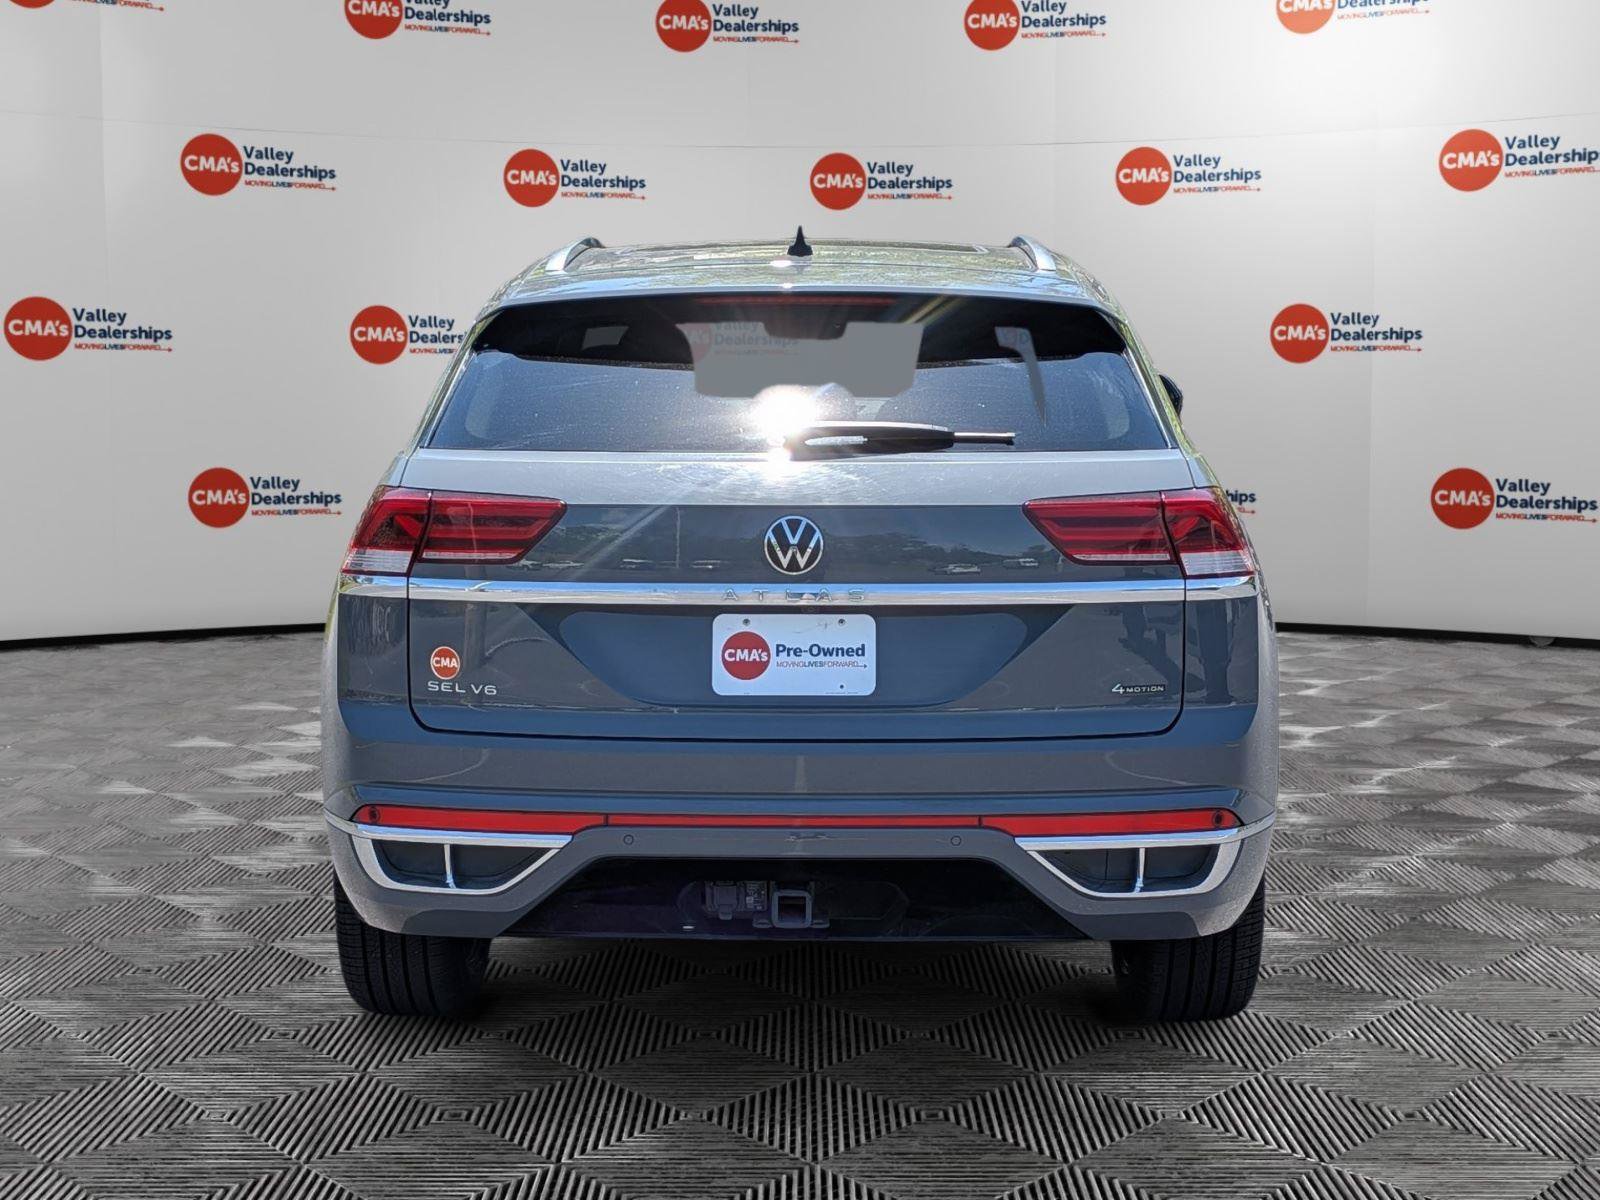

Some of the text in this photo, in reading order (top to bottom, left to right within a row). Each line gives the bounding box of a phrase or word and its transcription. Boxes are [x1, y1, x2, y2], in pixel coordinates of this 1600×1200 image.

[347, 0, 401, 18] CMA's
[712, 4, 759, 20] Valley
[1021, 0, 1067, 15] Valley
[404, 7, 491, 25] Dealerships
[659, 15, 709, 30] CMA's
[967, 13, 1018, 29] CMA's
[1021, 14, 1107, 28] Dealerships
[713, 19, 799, 35] Dealerships
[1504, 134, 1560, 150] Valley
[243, 146, 294, 162] Valley
[1173, 154, 1221, 169] Valley
[1442, 151, 1500, 169] CMA's
[184, 154, 239, 173] CMA's
[244, 161, 336, 181] Dealerships
[560, 159, 607, 175] Valley
[867, 161, 913, 176] Valley
[507, 169, 557, 185] CMA's
[561, 174, 646, 190] Dealerships
[813, 173, 863, 189] CMA's
[867, 175, 953, 191] Dealerships
[1118, 168, 1170, 184] CMA's
[1174, 168, 1261, 183] Dealerships
[73, 308, 127, 325] Valley
[408, 315, 455, 331] Valley
[1330, 312, 1380, 328] Valley
[8, 319, 69, 337] CMA's
[74, 325, 172, 342] Dealerships
[353, 326, 405, 343] CMA's
[1274, 324, 1326, 340] CMA's
[1331, 327, 1423, 343] Dealerships
[250, 476, 300, 492] Valley
[1495, 478, 1551, 495] Valley
[191, 489, 247, 506] CMA's
[251, 491, 342, 507] Dealerships
[1434, 489, 1491, 506] CMA's
[1496, 494, 1598, 511] Dealerships
[720, 588, 866, 602] ATLAS
[724, 648, 769, 662] CMA's
[775, 643, 866, 657] Pre-Owned
[432, 656, 458, 669] CMA
[427, 681, 497, 696] SEL V6
[1111, 683, 1165, 695] 4MOTION
